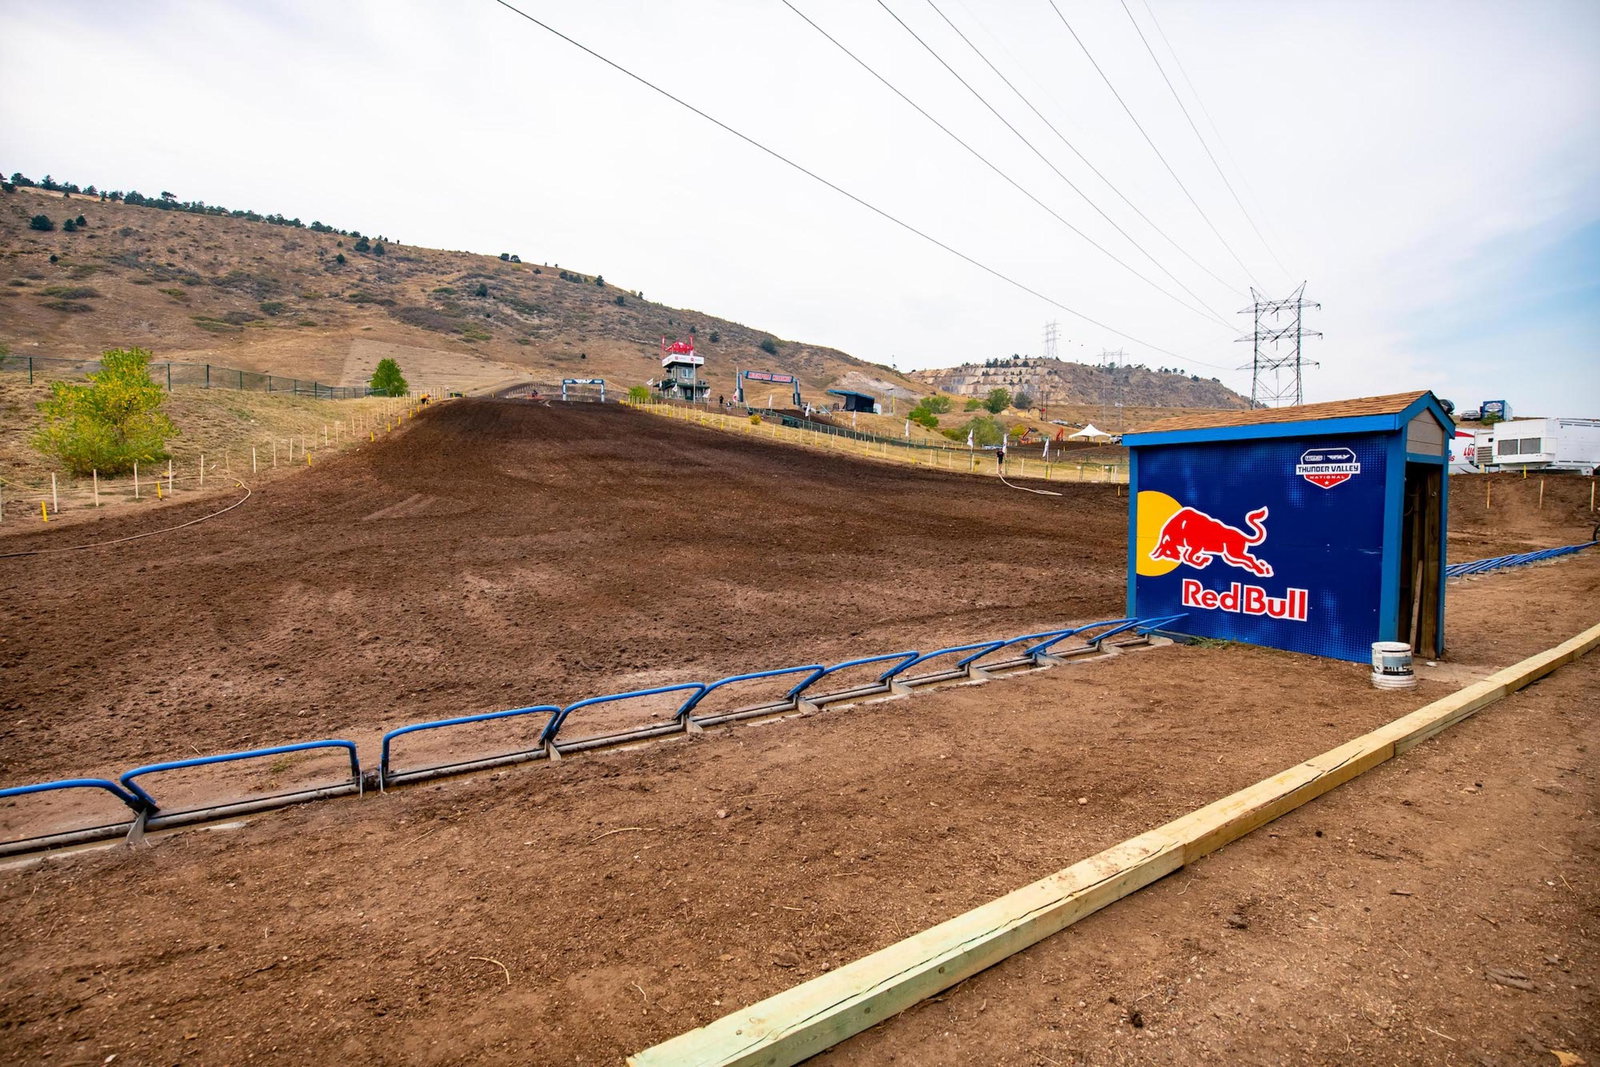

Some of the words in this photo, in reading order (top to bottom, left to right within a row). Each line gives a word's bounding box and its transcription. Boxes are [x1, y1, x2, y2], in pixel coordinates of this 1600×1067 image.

[1298, 465, 1330, 473] THUNDER
[1331, 464, 1359, 472] VALLEY
[1182, 578, 1241, 613] Red
[1243, 584, 1309, 622] Bull
